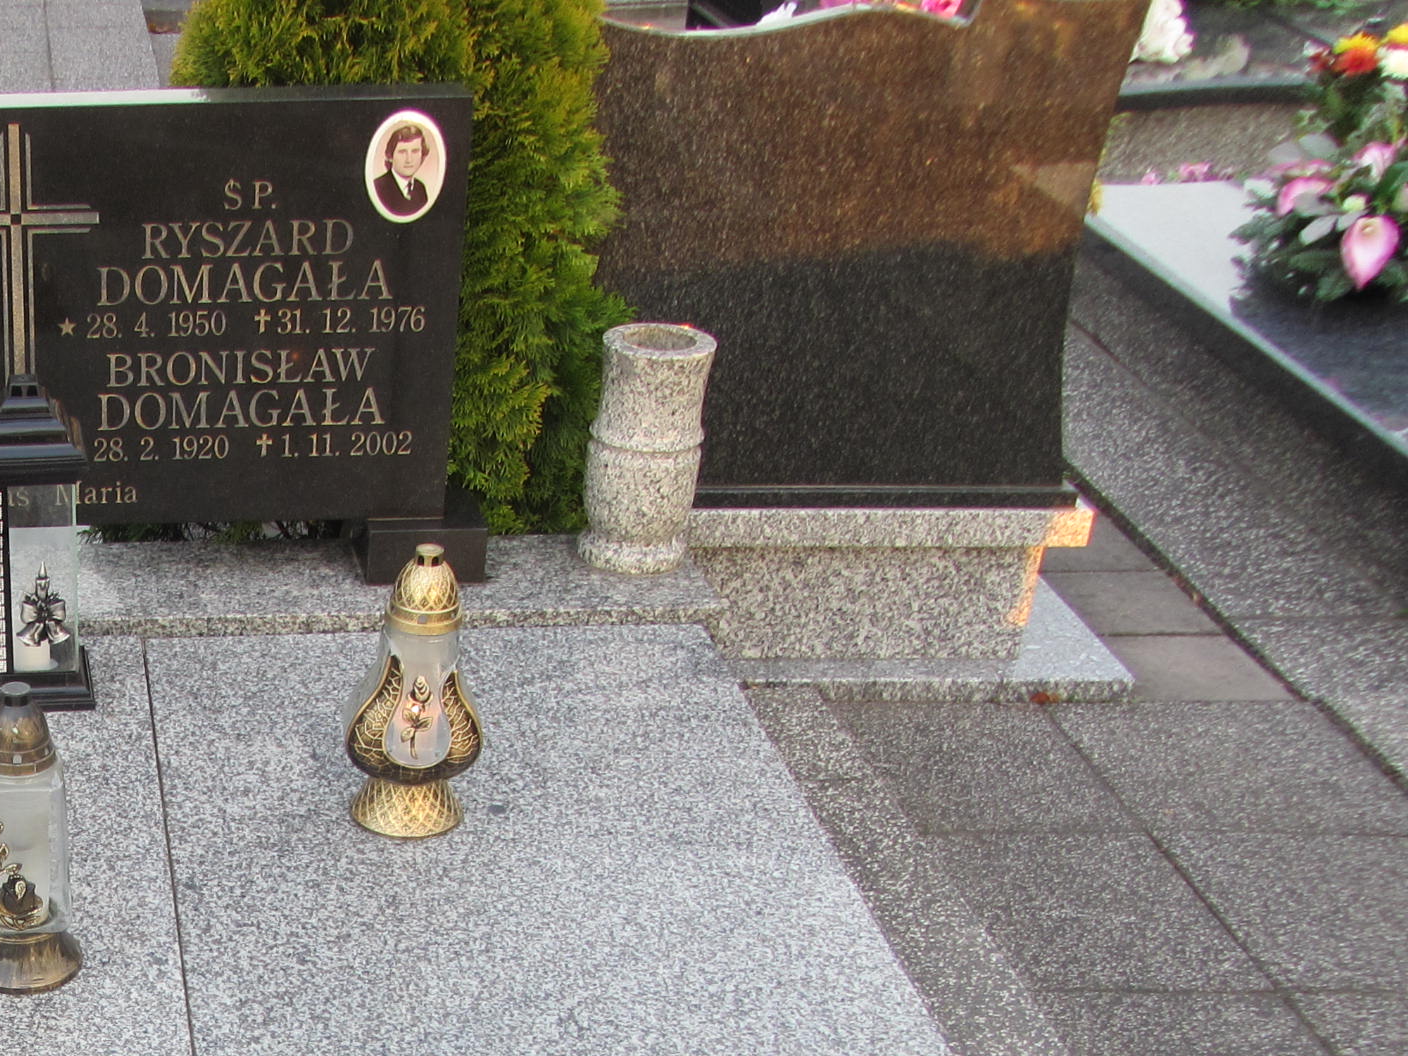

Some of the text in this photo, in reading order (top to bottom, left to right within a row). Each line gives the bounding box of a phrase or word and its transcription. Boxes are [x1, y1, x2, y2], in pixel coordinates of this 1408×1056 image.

[142, 218, 354, 259] RYSZARD
[96, 259, 393, 306] DOMAGAŁA
[87, 313, 123, 339] 28.
[134, 312, 155, 337] 4.
[168, 309, 227, 337] 1950
[322, 307, 356, 333] 12.
[369, 306, 426, 333] 1976
[105, 347, 376, 388] BRONISŁAW
[96, 387, 386, 431] DOMAGAŁA
[94, 438, 128, 462] 28.
[140, 437, 159, 461] 2.
[172, 435, 230, 460] 1920
[308, 432, 340, 457] 11.
[350, 431, 413, 456] 2002
[55, 480, 138, 506] Maria
